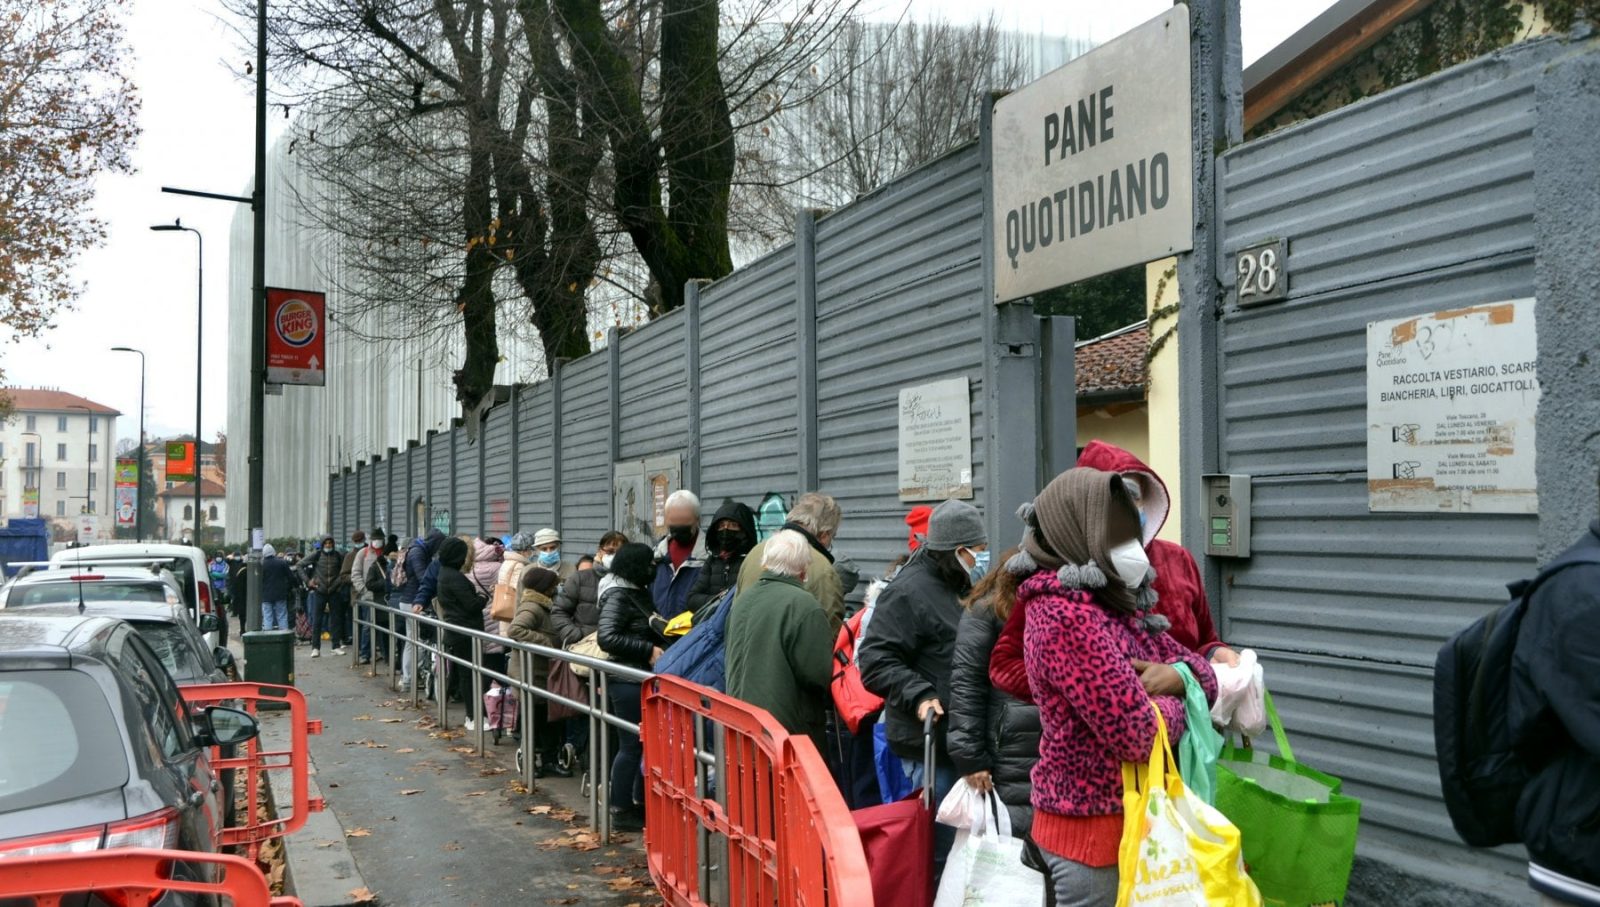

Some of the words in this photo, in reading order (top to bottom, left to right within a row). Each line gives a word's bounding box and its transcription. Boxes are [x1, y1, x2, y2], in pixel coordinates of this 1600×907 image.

[1044, 84, 1114, 167] PANE
[1006, 152, 1170, 269] QUOTIDIANO
[1238, 248, 1276, 297] 28
[281, 310, 312, 324] BURGER
[282, 318, 313, 335] KING
[1376, 357, 1407, 368] Quotidiano
[1393, 371, 1442, 385] RACCOLTA
[1443, 365, 1498, 381] VESTIARIO,
[1380, 388, 1439, 402] BIANCHERIA,
[1440, 385, 1468, 398] LIBRI,
[1470, 379, 1535, 395] GIOCATTOLI,
